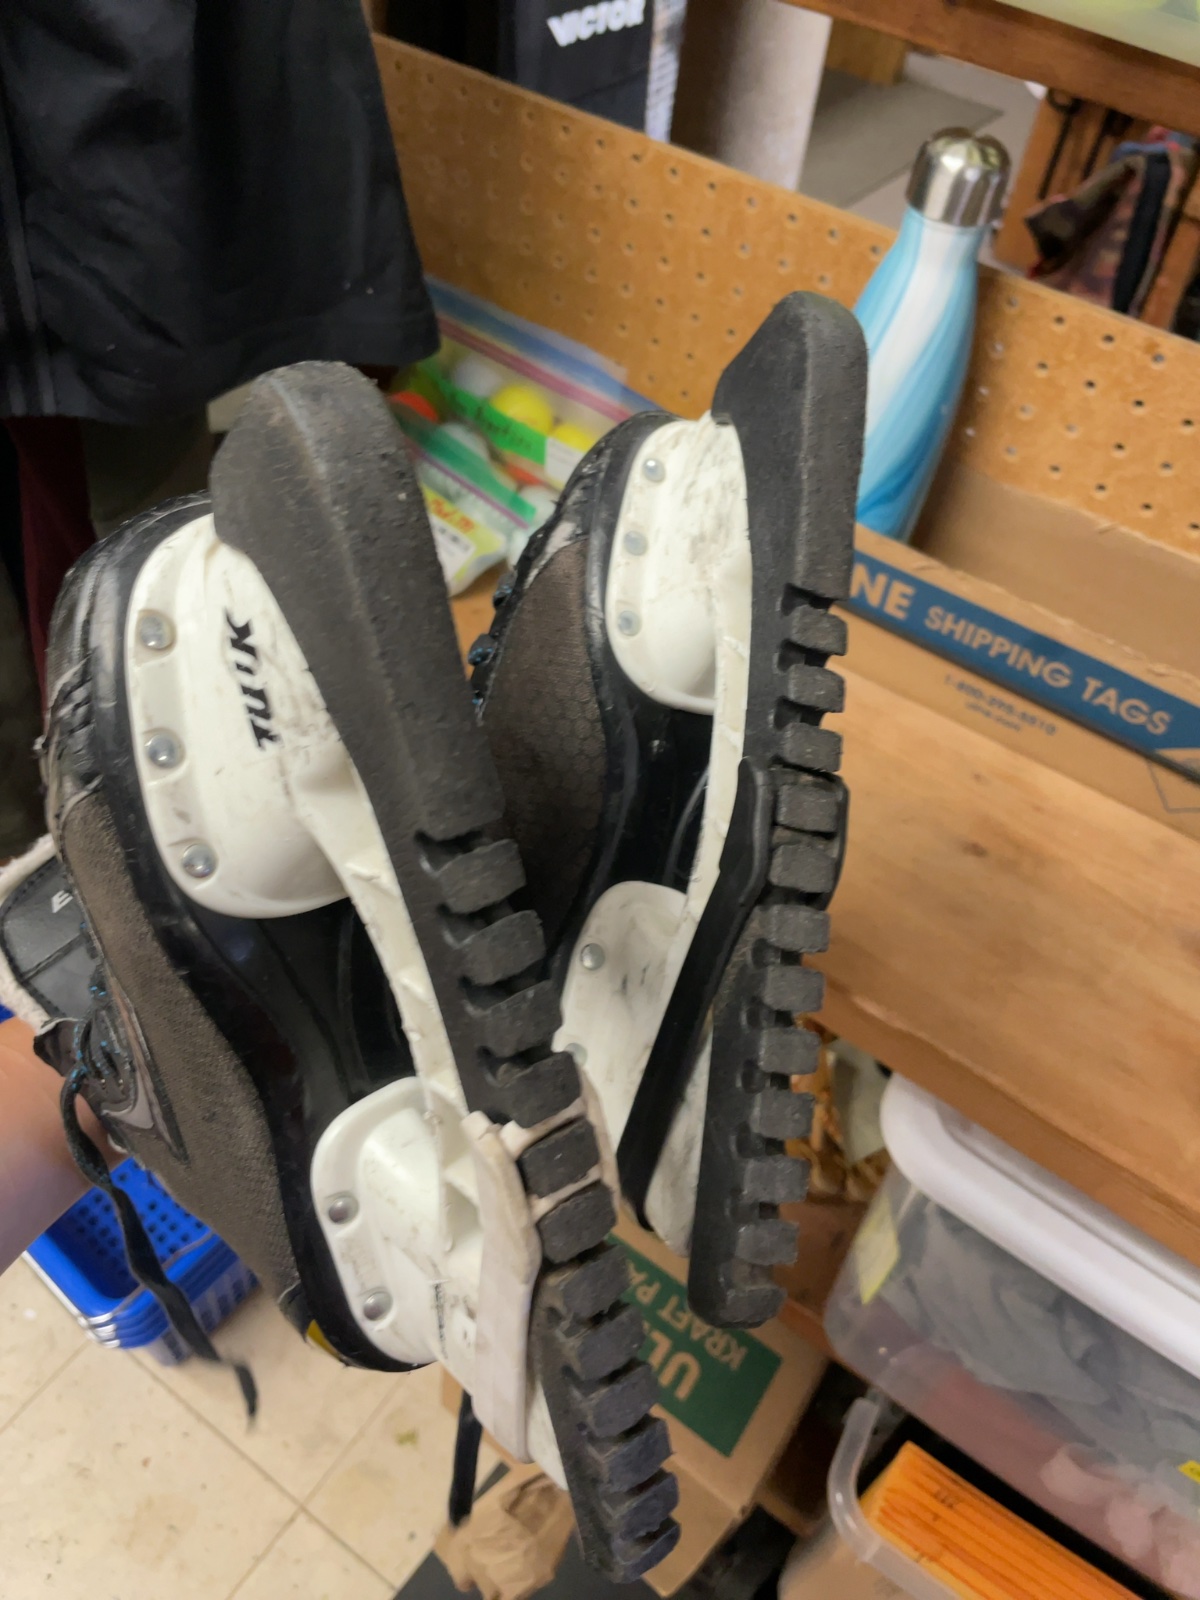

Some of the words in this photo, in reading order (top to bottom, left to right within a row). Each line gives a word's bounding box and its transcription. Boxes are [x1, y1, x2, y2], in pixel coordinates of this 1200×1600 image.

[850, 562, 917, 621] NE
[924, 605, 1073, 688] SHIPPING
[1081, 676, 1173, 735] TAGS
[627, 1259, 661, 1305] PA
[643, 1321, 702, 1401] UL
[656, 1295, 749, 1371] KRAFT
